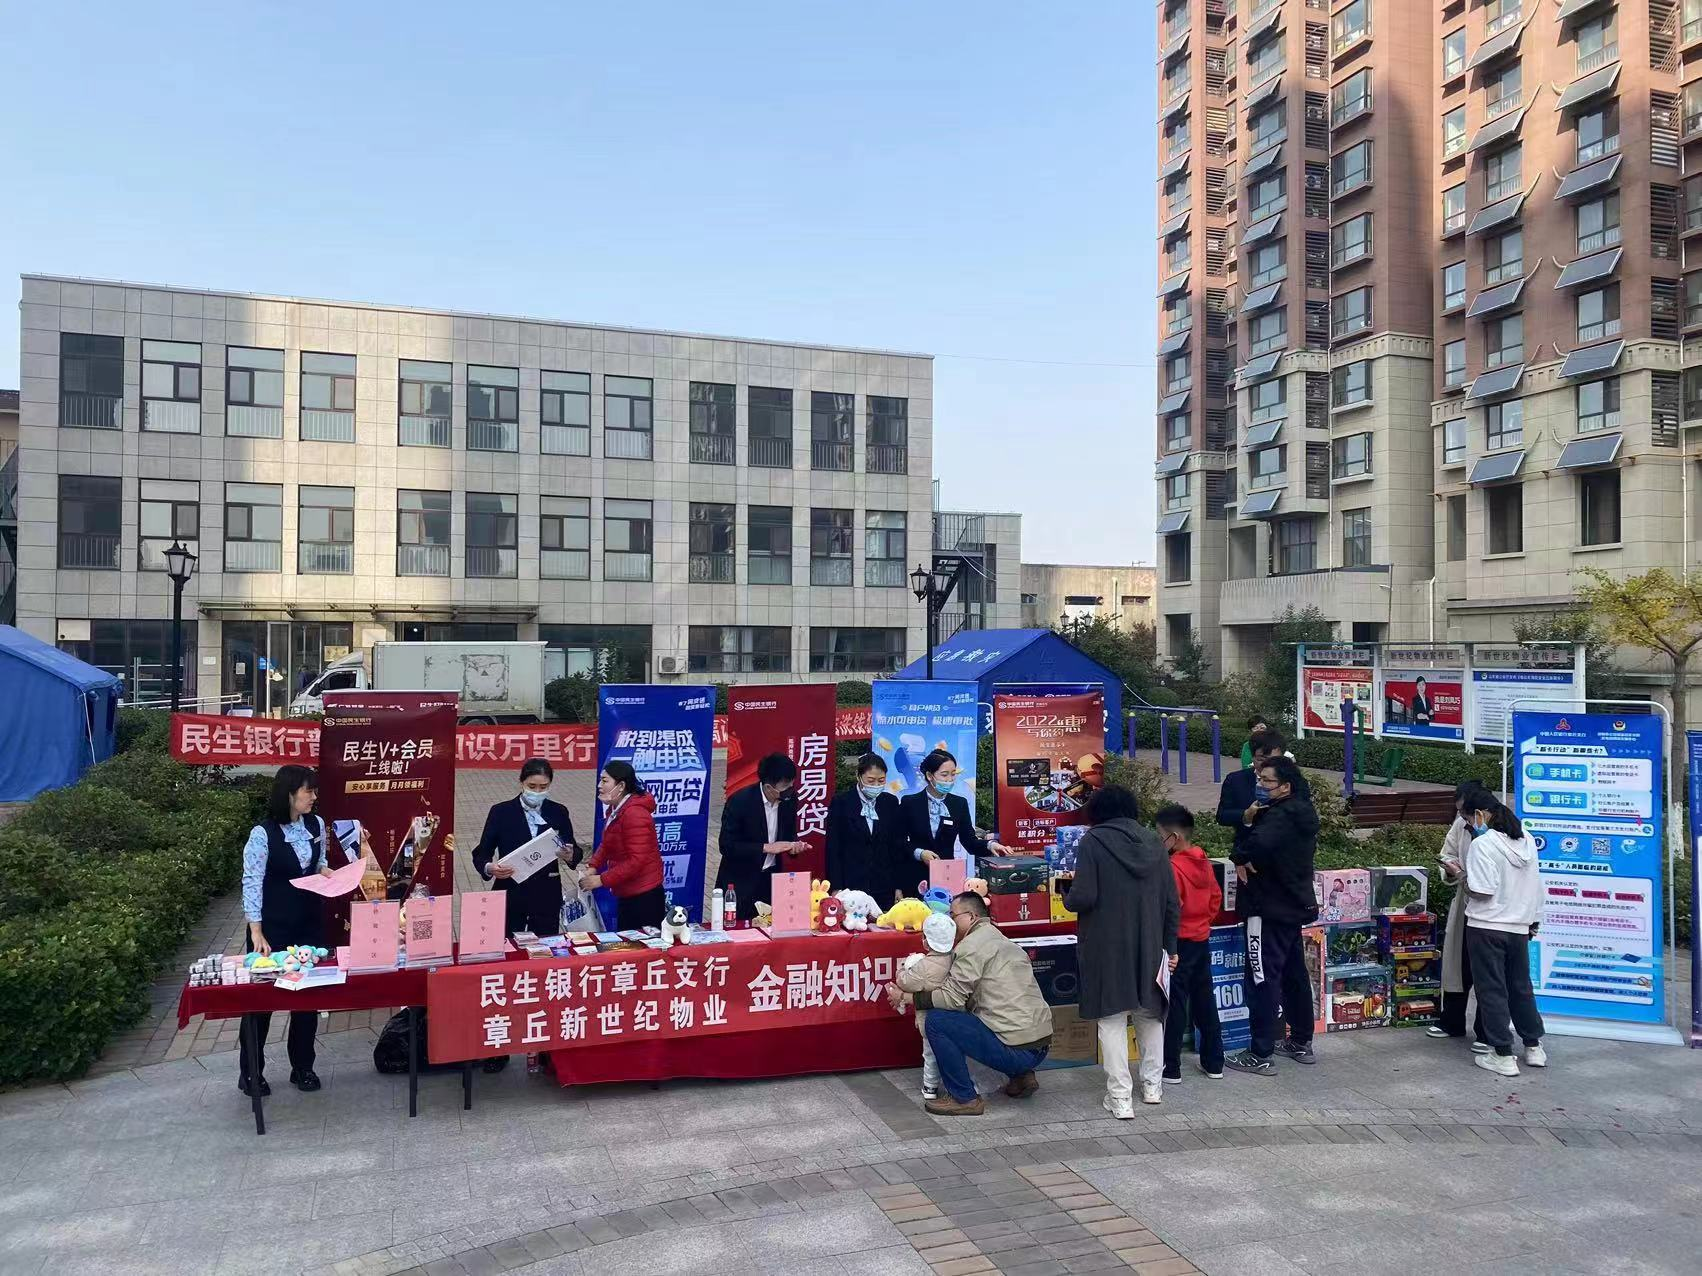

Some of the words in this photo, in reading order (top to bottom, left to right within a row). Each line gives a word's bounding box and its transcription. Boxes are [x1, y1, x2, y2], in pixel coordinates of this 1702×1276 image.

[1311, 651, 1365, 659] 新世纪物业宣传栏
[1391, 651, 1455, 660] 新世纪物业宣传栏
[1484, 652, 1560, 661] 新世纪物业宣传栏
[615, 729, 696, 748] 税到渠成
[343, 739, 434, 762] 民生V+会员
[610, 747, 703, 771] 一触申贷
[796, 732, 829, 837] 房易贷
[1549, 768, 1582, 779] 手机卡
[1550, 794, 1582, 806] 银行卡
[1018, 829, 1046, 838] 送积分
[1250, 934, 1261, 973] Kappa
[479, 955, 730, 1009] 民生银行章丘支行
[747, 957, 908, 1013] 金融知识
[1213, 983, 1244, 1009] 160
[482, 993, 728, 1049] 章丘新世纪物业
